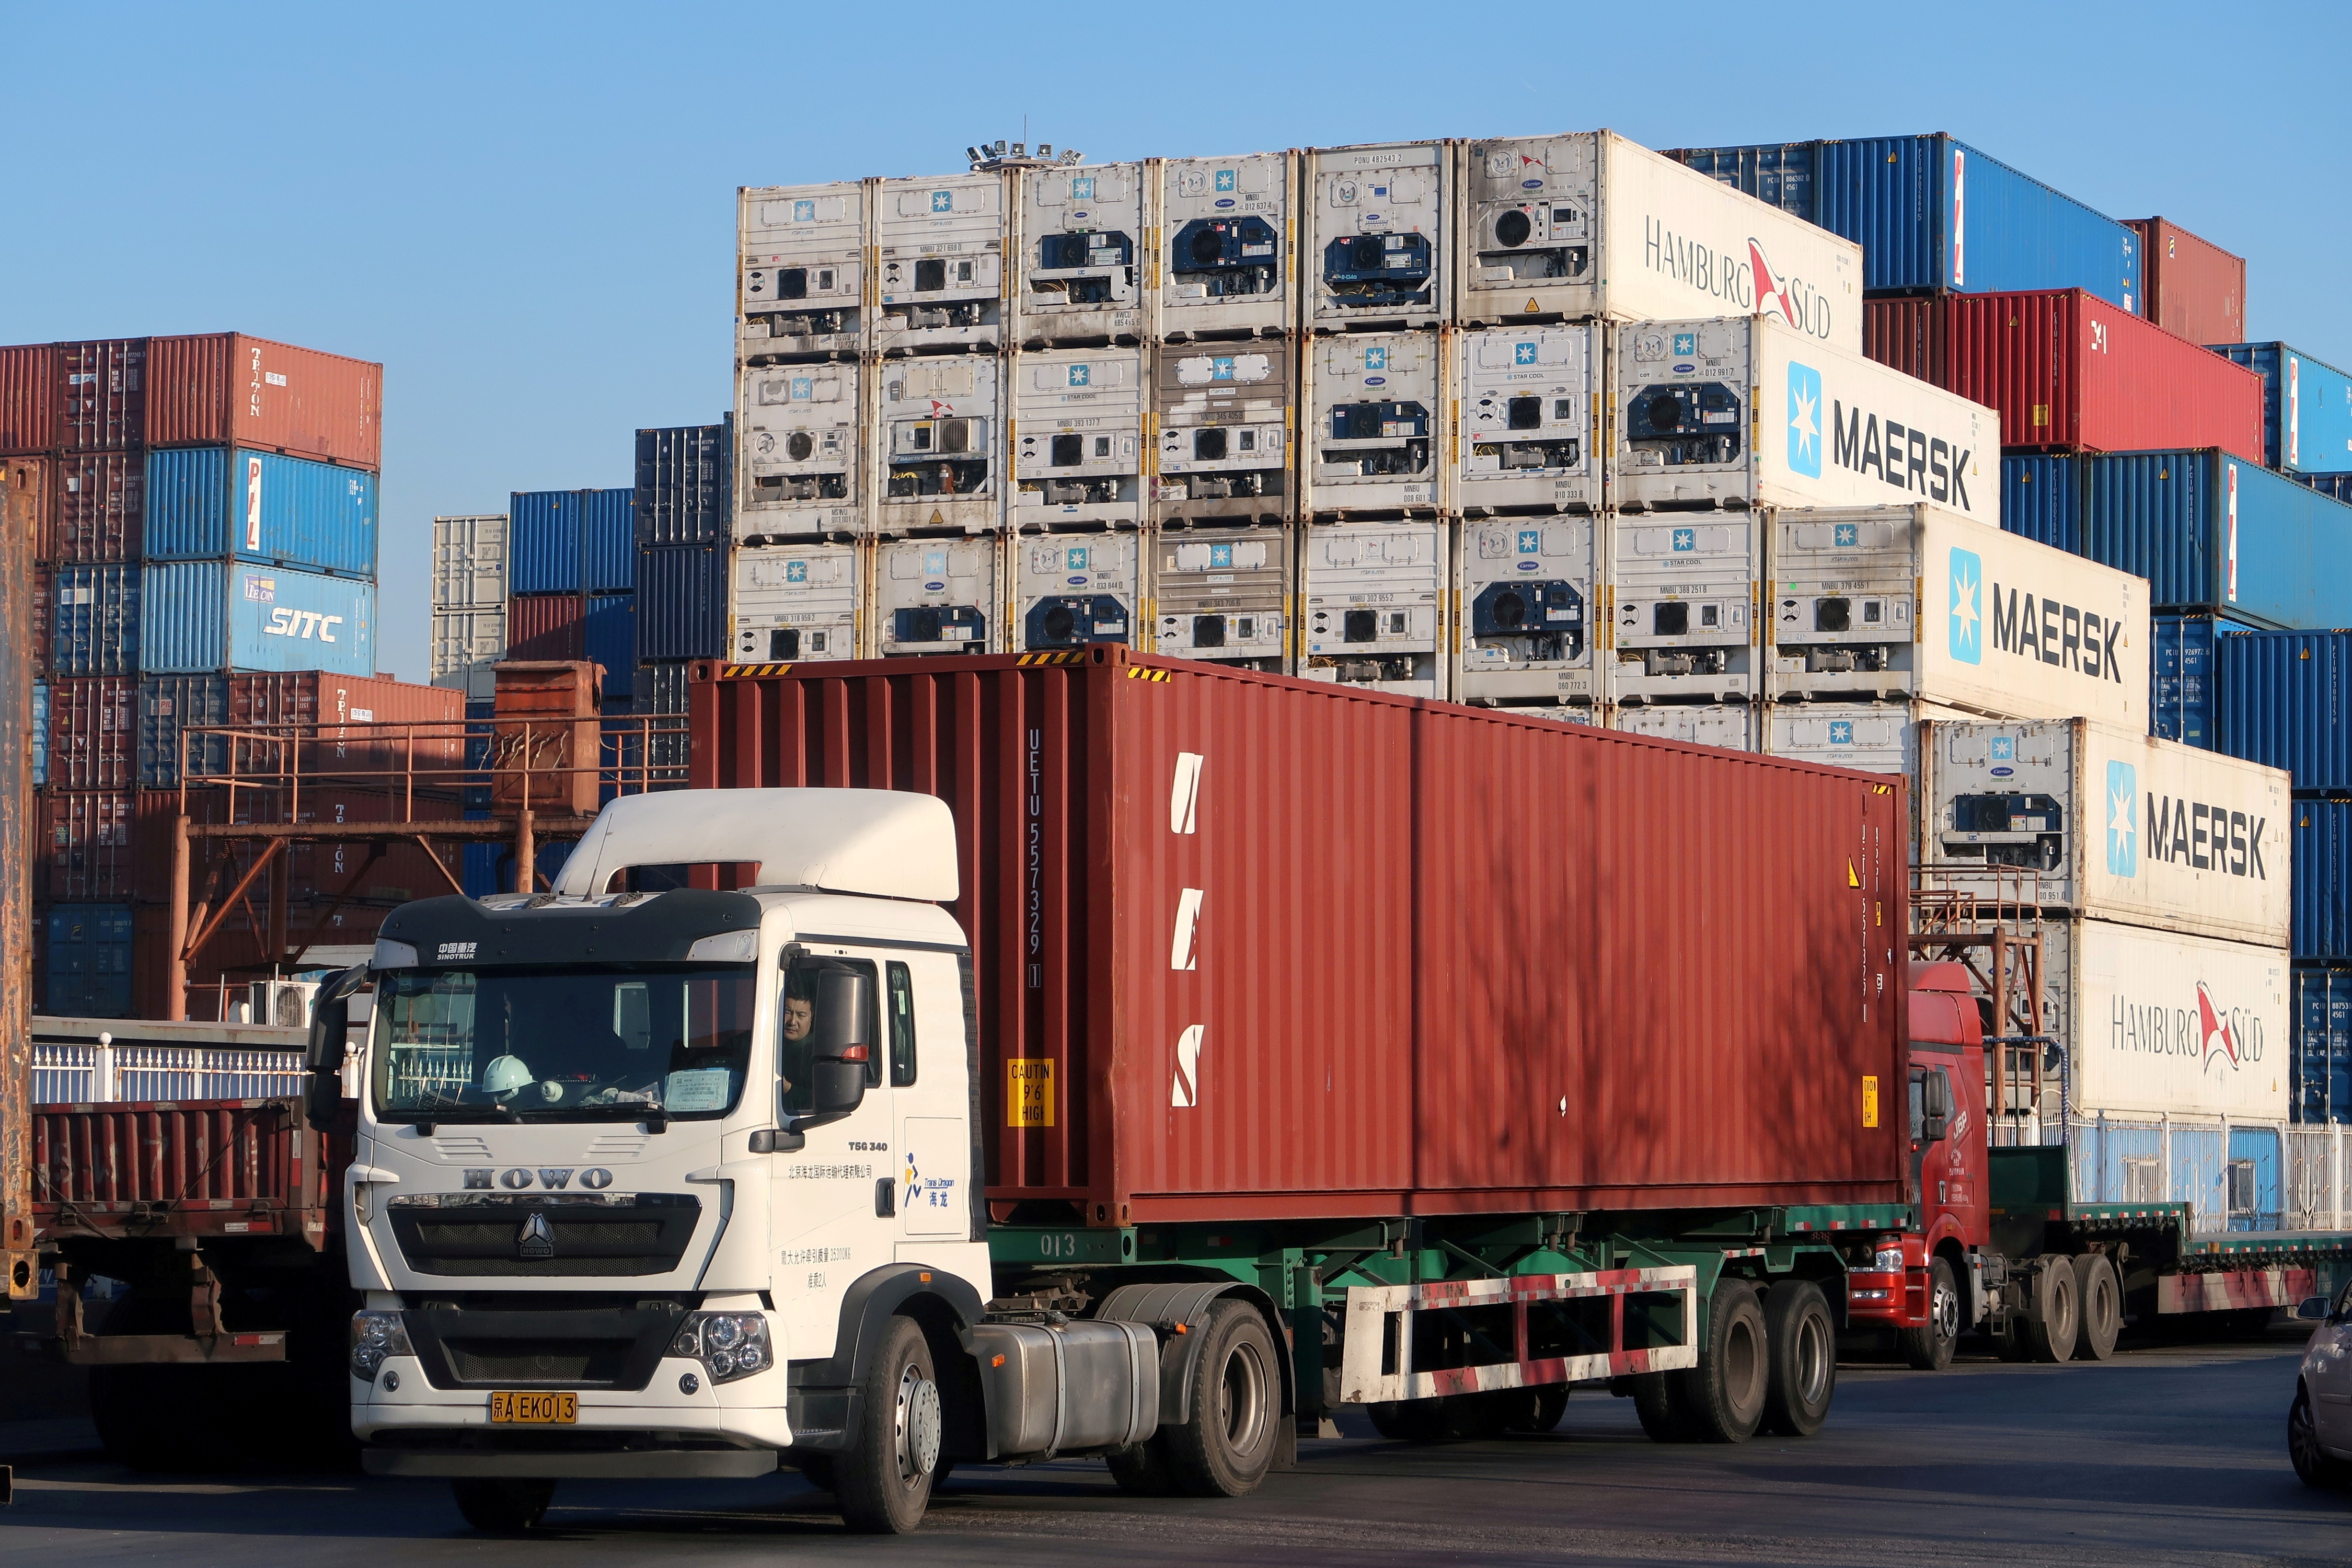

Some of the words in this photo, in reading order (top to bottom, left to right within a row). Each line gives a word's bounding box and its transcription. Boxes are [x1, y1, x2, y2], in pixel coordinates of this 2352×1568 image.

[1372, 155, 1396, 163] 482543
[1646, 214, 1751, 309] HAMBURG
[1792, 278, 1831, 340] SÜD
[250, 348, 261, 417] TRITON
[1705, 368, 1717, 377] 012
[1834, 399, 1971, 512] MAERSK
[247, 463, 259, 545] PIL
[263, 607, 343, 643] SITC
[1993, 582, 2122, 684] MAERSK
[1029, 730, 1040, 816] UETU
[2147, 791, 2266, 881] MAERSK
[1029, 824, 1040, 955] 557329
[439, 942, 477, 954] 中国重汽
[2112, 993, 2198, 1058] HAMBURG
[2232, 1005, 2263, 1062] SÜD
[1953, 1110, 1967, 1137] J6P
[848, 1142, 868, 1151] T5G
[869, 1142, 888, 1152] 340
[462, 1167, 615, 1191] HOWO
[788, 1165, 872, 1180] 北京海龙国际运输代理有限公司
[924, 1178, 937, 1187] Trans
[938, 1178, 954, 1189] Dragon
[523, 1247, 549, 1255] HOWO
[1041, 1234, 1075, 1257] 013
[807, 1272, 827, 1289] 准乘2人
